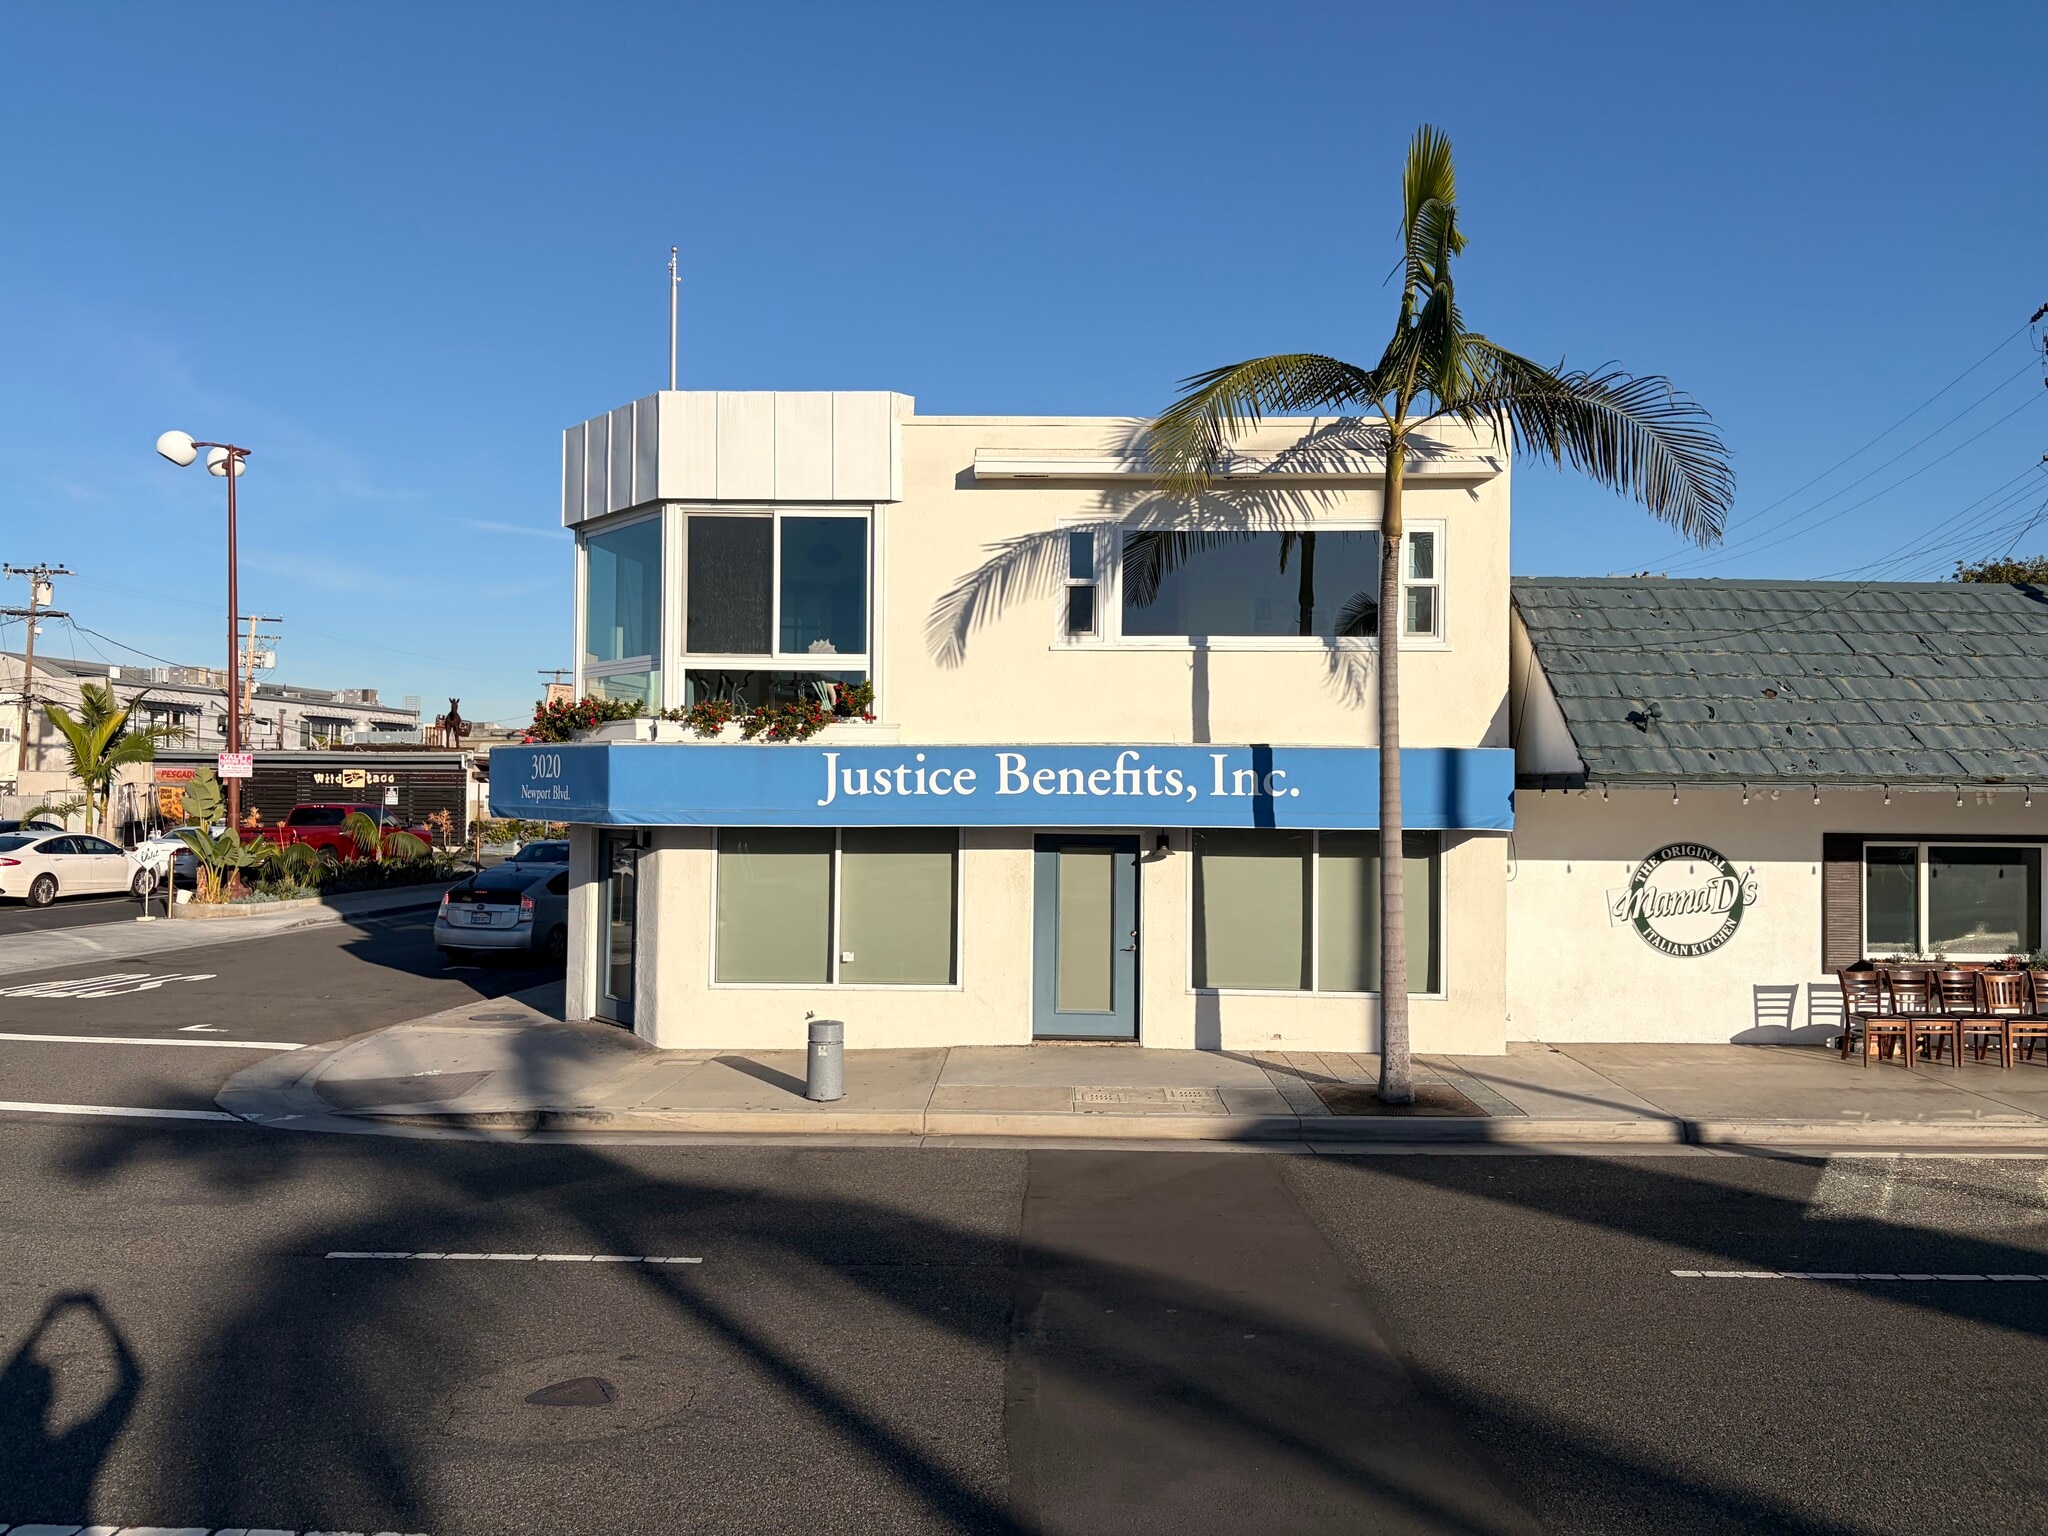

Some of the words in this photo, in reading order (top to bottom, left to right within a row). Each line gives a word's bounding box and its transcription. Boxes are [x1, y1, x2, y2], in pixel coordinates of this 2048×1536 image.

[313, 772, 342, 784] Wild
[531, 754, 561, 779] 3020
[817, 752, 977, 806] Justice
[995, 750, 1197, 802] Benefits,
[1209, 753, 1300, 798] Inc.
[521, 784, 551, 803] Newport
[553, 785, 571, 800] Blvd.
[1635, 856, 1661, 883] THE
[1661, 845, 1727, 872] ORIGINAL
[1642, 927, 1689, 956] ITALIAN
[1691, 918, 1738, 956] KITCHEN
